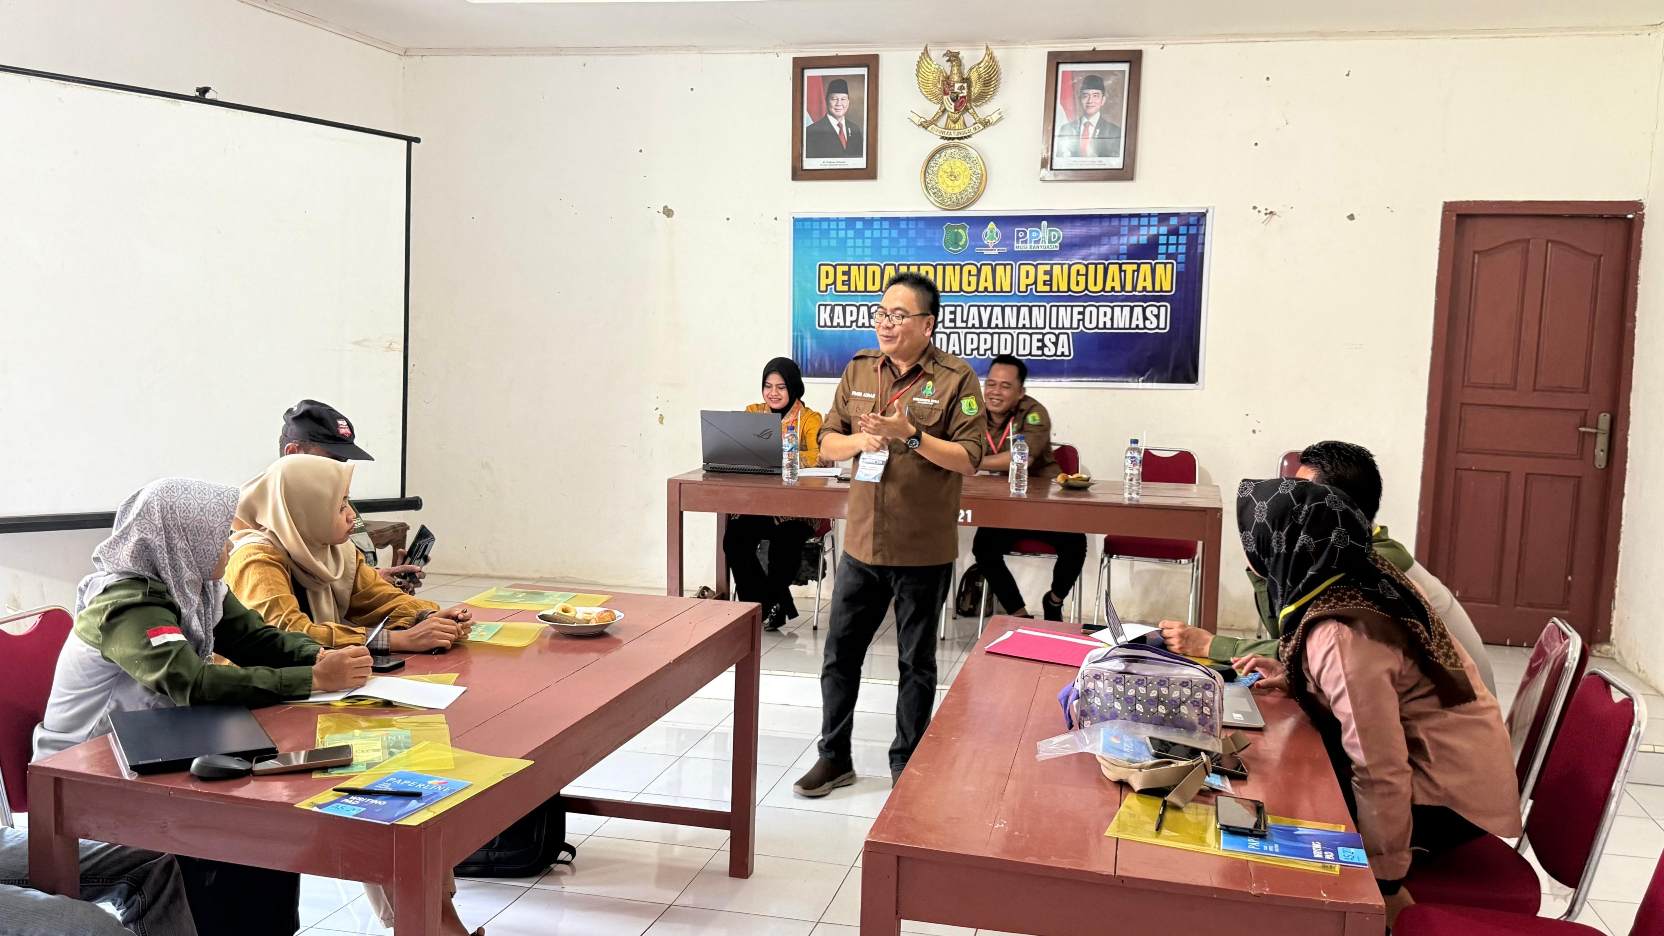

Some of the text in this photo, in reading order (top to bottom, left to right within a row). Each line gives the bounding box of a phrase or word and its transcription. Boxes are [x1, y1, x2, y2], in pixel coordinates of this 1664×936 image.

[1015, 220, 1062, 245] PPID
[1018, 262, 1174, 293] PENGUATAN
[1050, 304, 1167, 330] INFORMASI
[965, 332, 1014, 356] PPID
[1017, 332, 1071, 356] DESA
